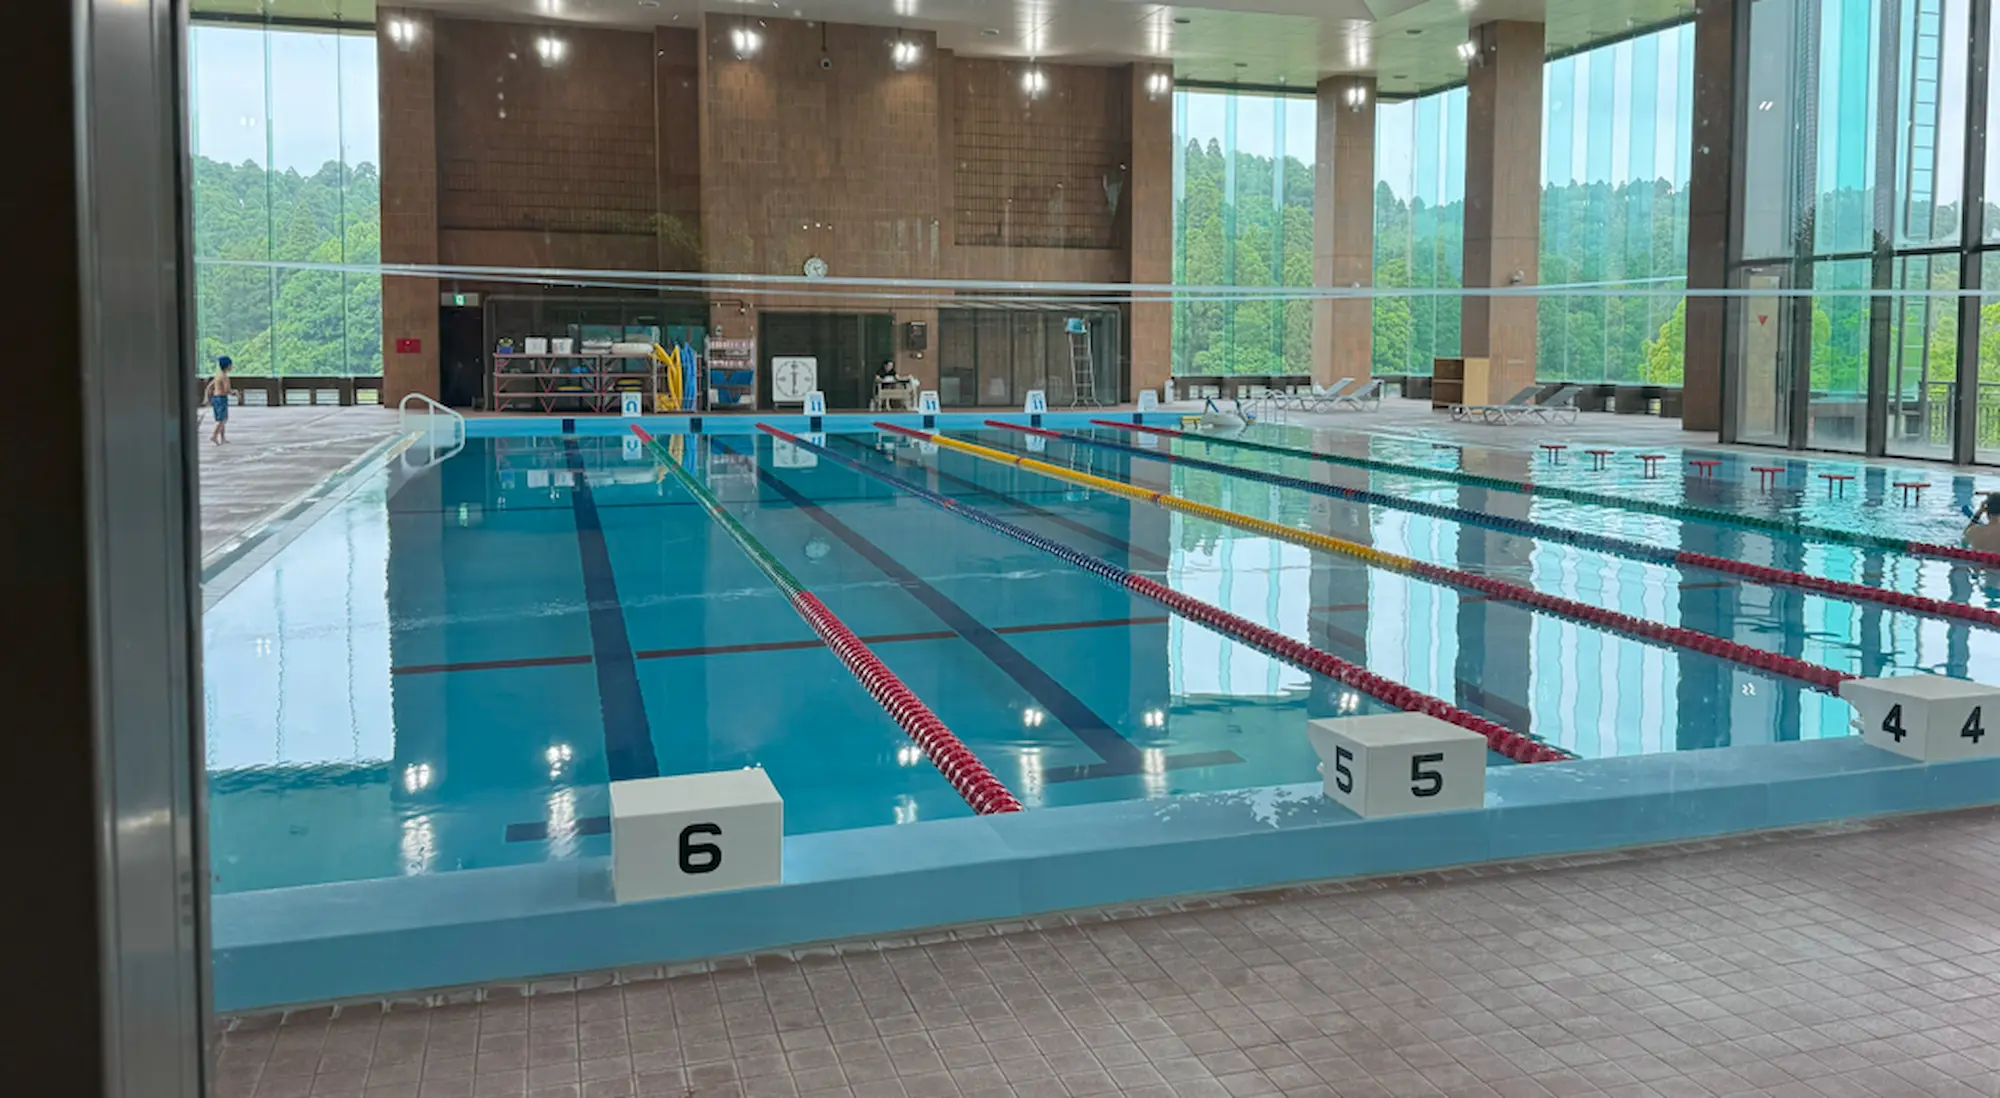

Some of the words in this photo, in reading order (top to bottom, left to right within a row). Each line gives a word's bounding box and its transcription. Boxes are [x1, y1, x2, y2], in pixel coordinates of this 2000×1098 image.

[1882, 703, 1907, 743] 4
[1960, 705, 1985, 744] 4
[1335, 745, 1353, 795] 5
[1411, 753, 1444, 797] 5
[679, 822, 722, 875] 6
